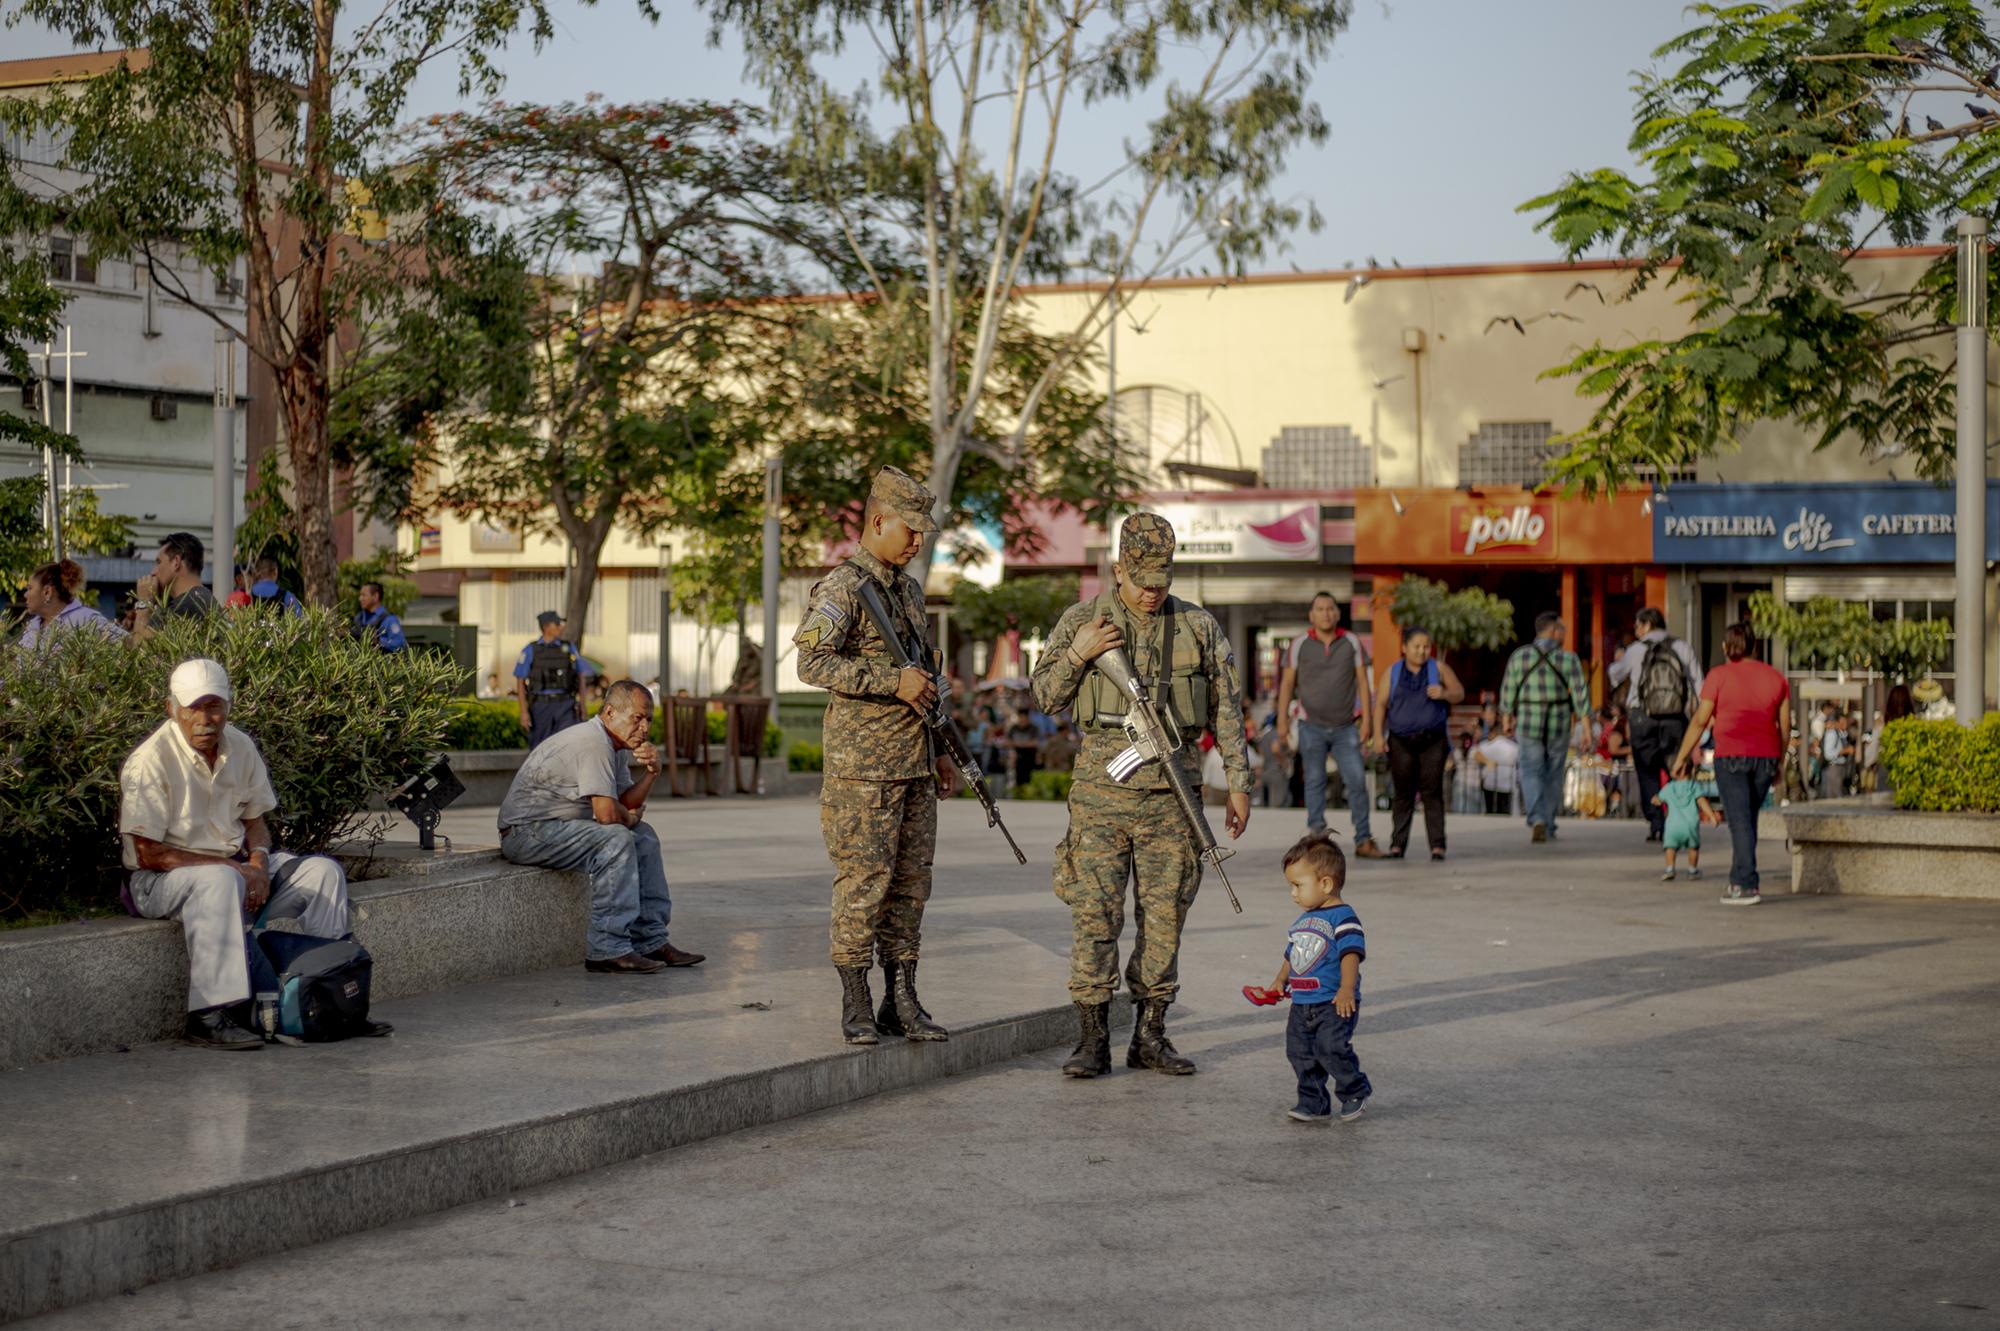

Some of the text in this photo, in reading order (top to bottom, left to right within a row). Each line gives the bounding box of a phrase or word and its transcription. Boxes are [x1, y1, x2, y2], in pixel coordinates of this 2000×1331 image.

[1464, 506, 1545, 556] pollo
[1664, 515, 1777, 537] PASTELERIA
[1862, 514, 1957, 535] CAFETERI
